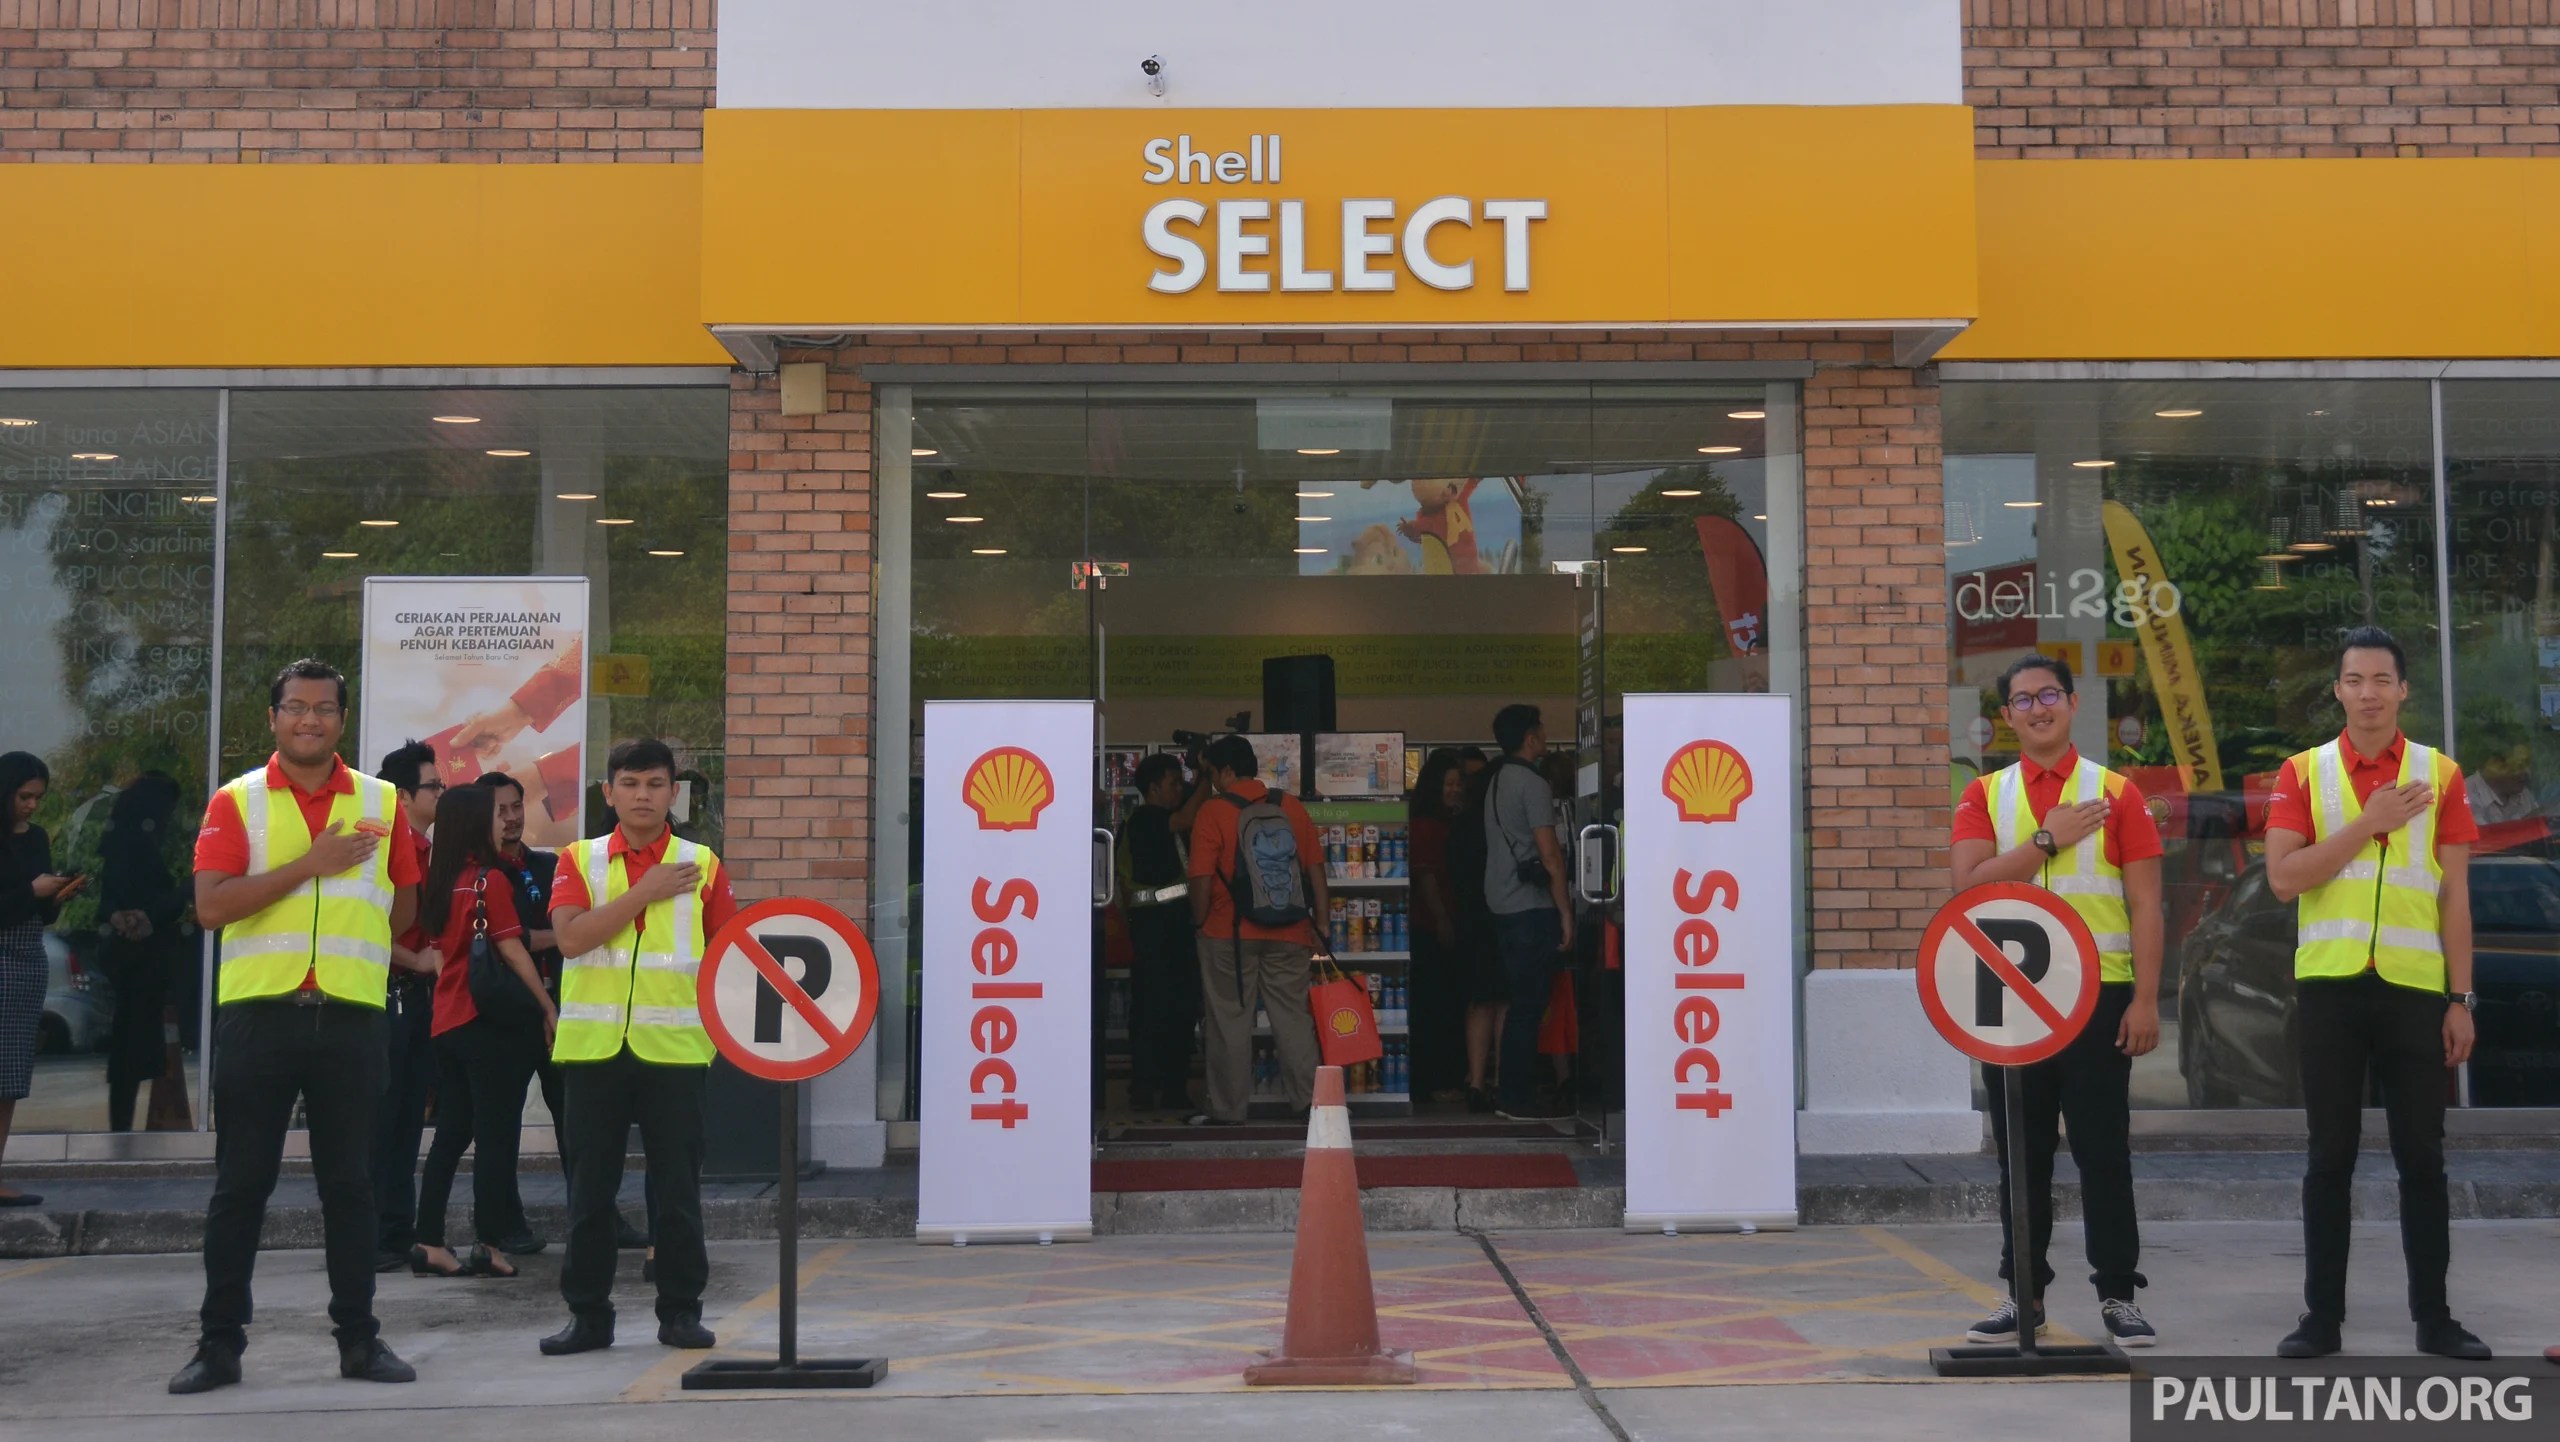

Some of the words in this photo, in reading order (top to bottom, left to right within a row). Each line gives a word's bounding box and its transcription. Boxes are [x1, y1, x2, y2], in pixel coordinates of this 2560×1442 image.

[1142, 134, 1281, 185] Shell
[1141, 195, 1548, 294] SELECT
[130, 420, 218, 444] ASIAN
[112, 456, 218, 480] RANGE
[38, 491, 218, 518] QUENCHING
[11, 528, 119, 553] POTATO
[122, 527, 217, 553] sardine
[2486, 516, 2533, 543] OIL
[1955, 567, 2182, 629] deli2go
[2303, 590, 2494, 615] CHOCOLATE
[395, 613, 465, 624] CERIAKAN
[470, 613, 561, 624] PERJALANAN
[414, 626, 454, 637] AGAR
[458, 626, 541, 637] PERTEMUAN
[400, 639, 447, 650] PENUH
[451, 639, 554, 650] KEBAHAGIAAN
[434, 653, 462, 661] Selamat
[463, 653, 484, 661] Tahun
[486, 653, 502, 661] Baru
[503, 653, 519, 661] Cina
[970, 876, 1043, 1129] Select
[1672, 867, 1745, 1119] Select
